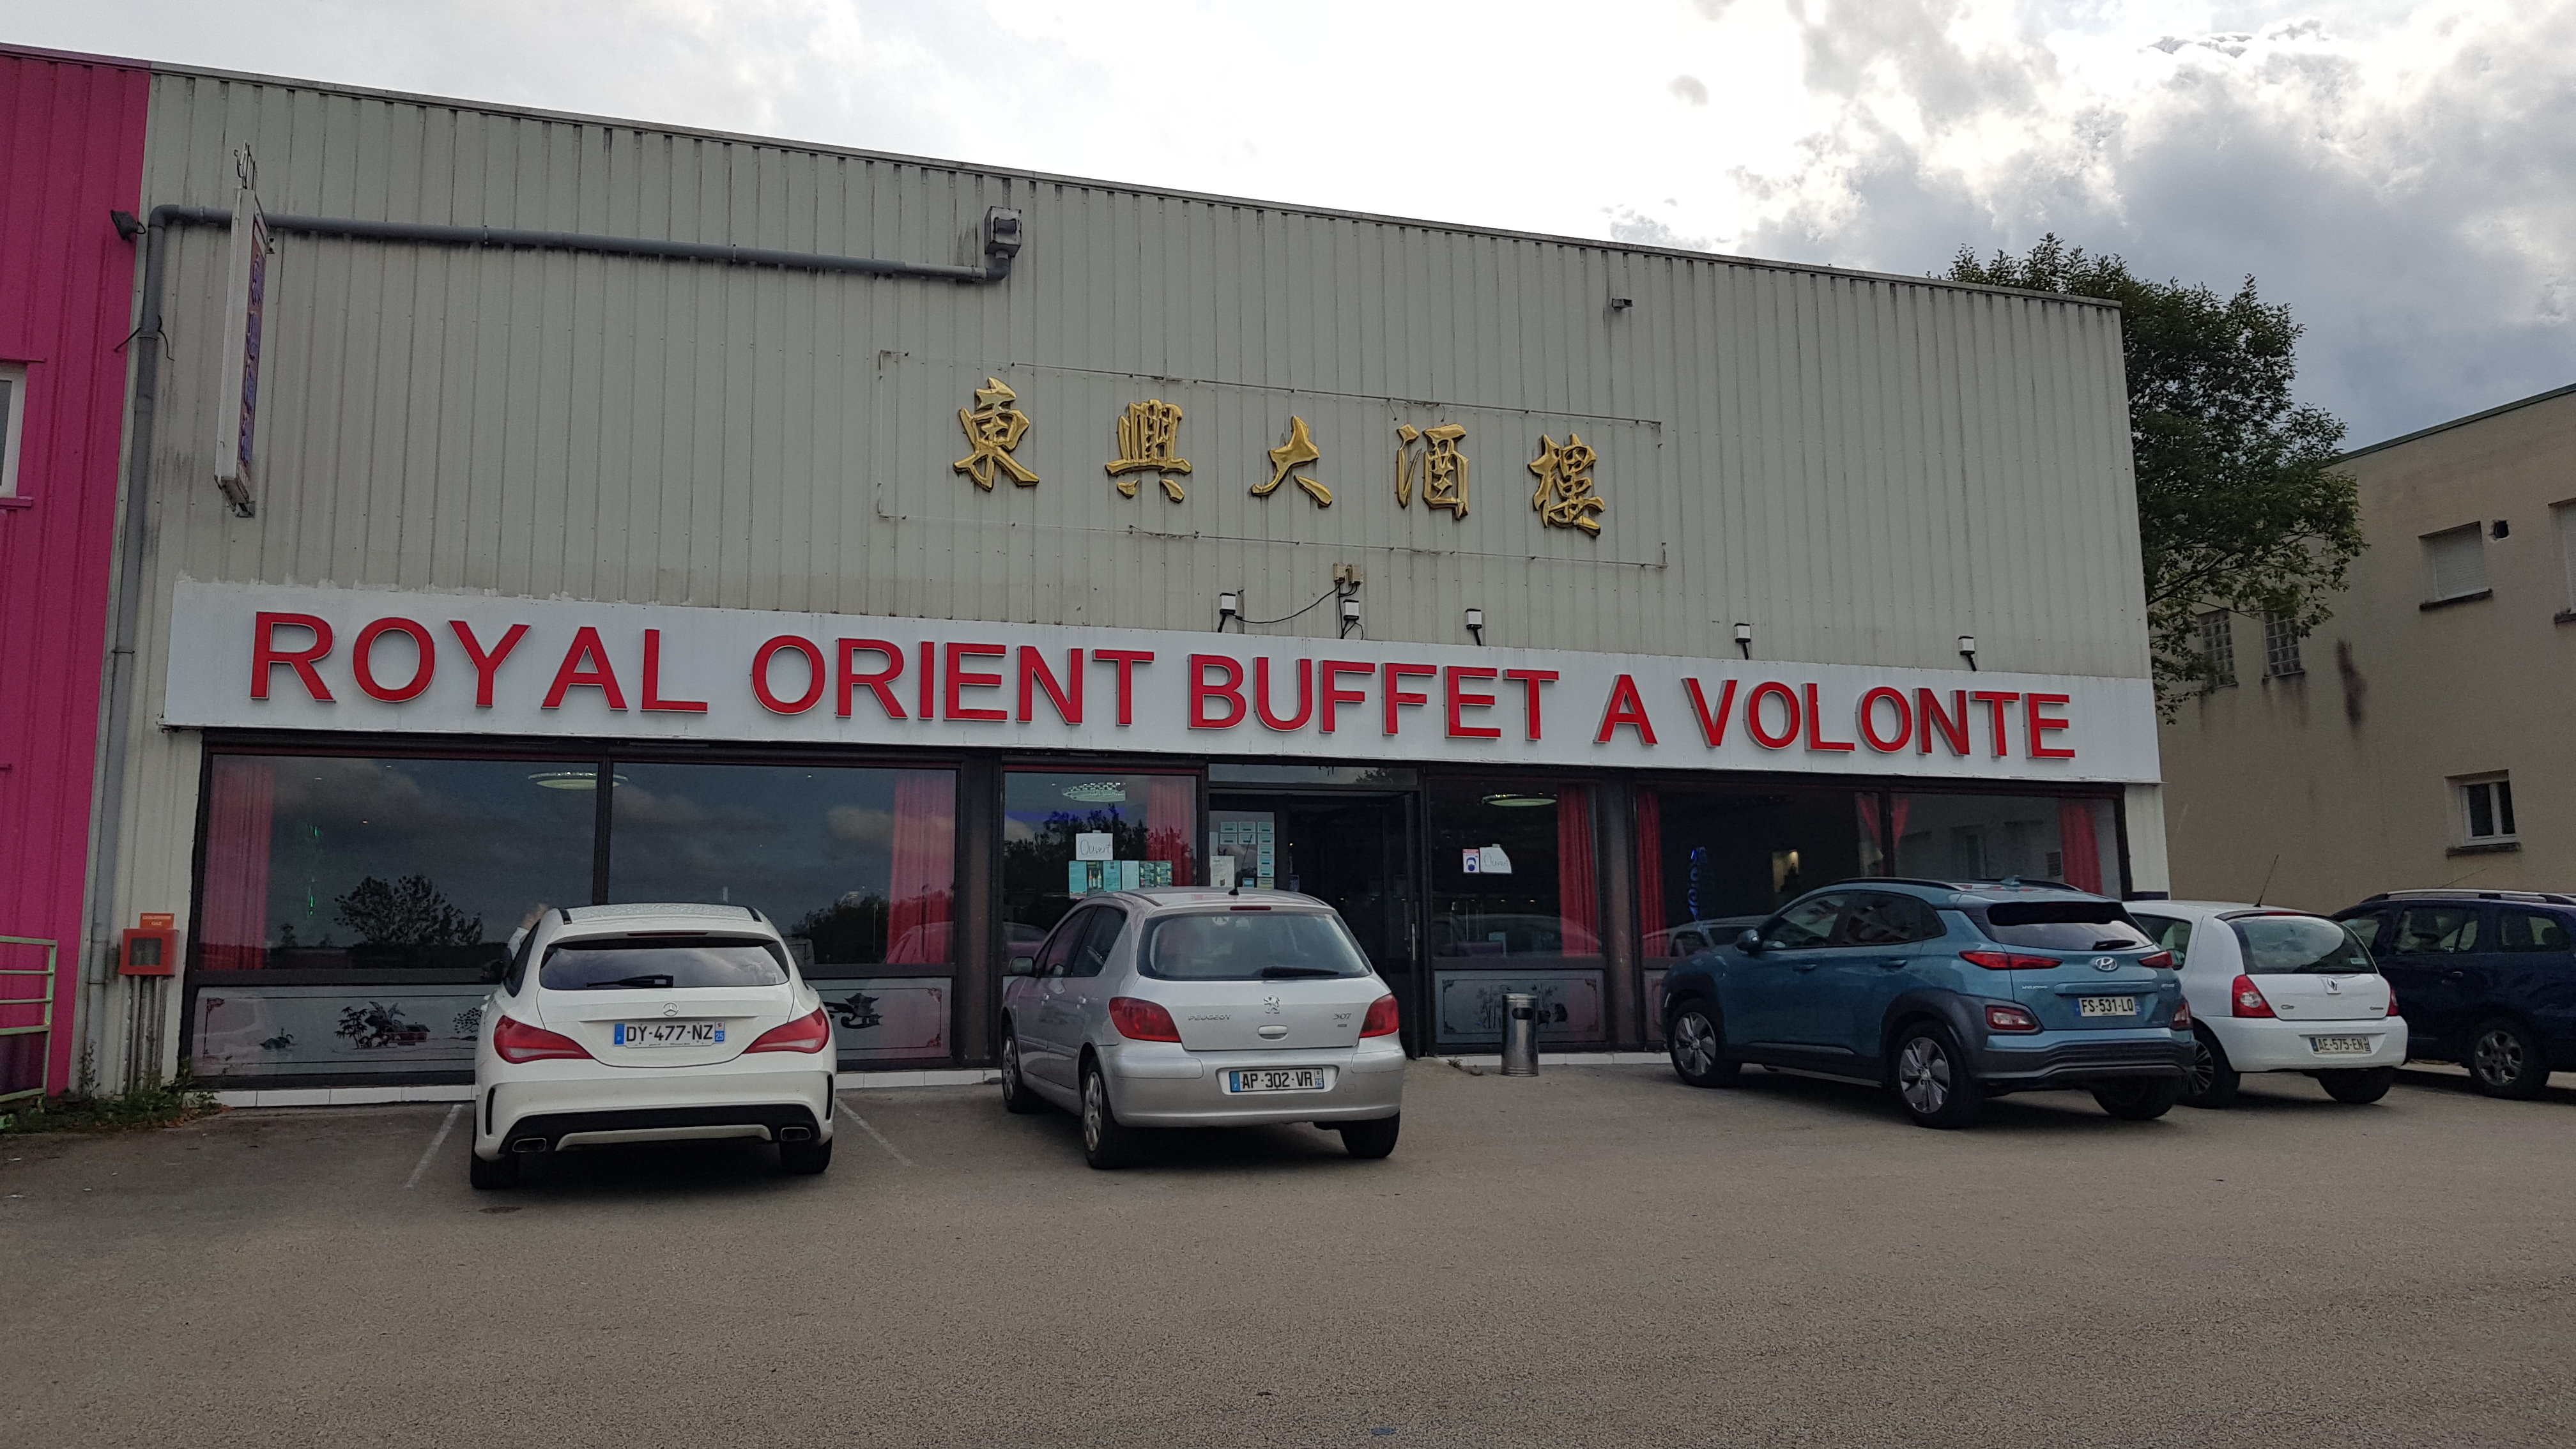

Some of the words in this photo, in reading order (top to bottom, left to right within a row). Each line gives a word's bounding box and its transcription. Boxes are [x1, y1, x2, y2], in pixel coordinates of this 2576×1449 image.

[953, 376, 1606, 536] 東興大酒樓
[250, 611, 708, 714] ROYAL
[751, 634, 1154, 727] ORIENT
[1188, 654, 1560, 741] BUFFET
[1593, 674, 1658, 746] A
[1681, 677, 2076, 759] VOLONTE
[1080, 839, 1112, 855] Ouvert
[626, 1025, 714, 1042] DY-477-NZ
[715, 1032, 724, 1041] 25
[2318, 1038, 2364, 1051] AE-575-EN
[1242, 1071, 1313, 1089] AP-302-VR
